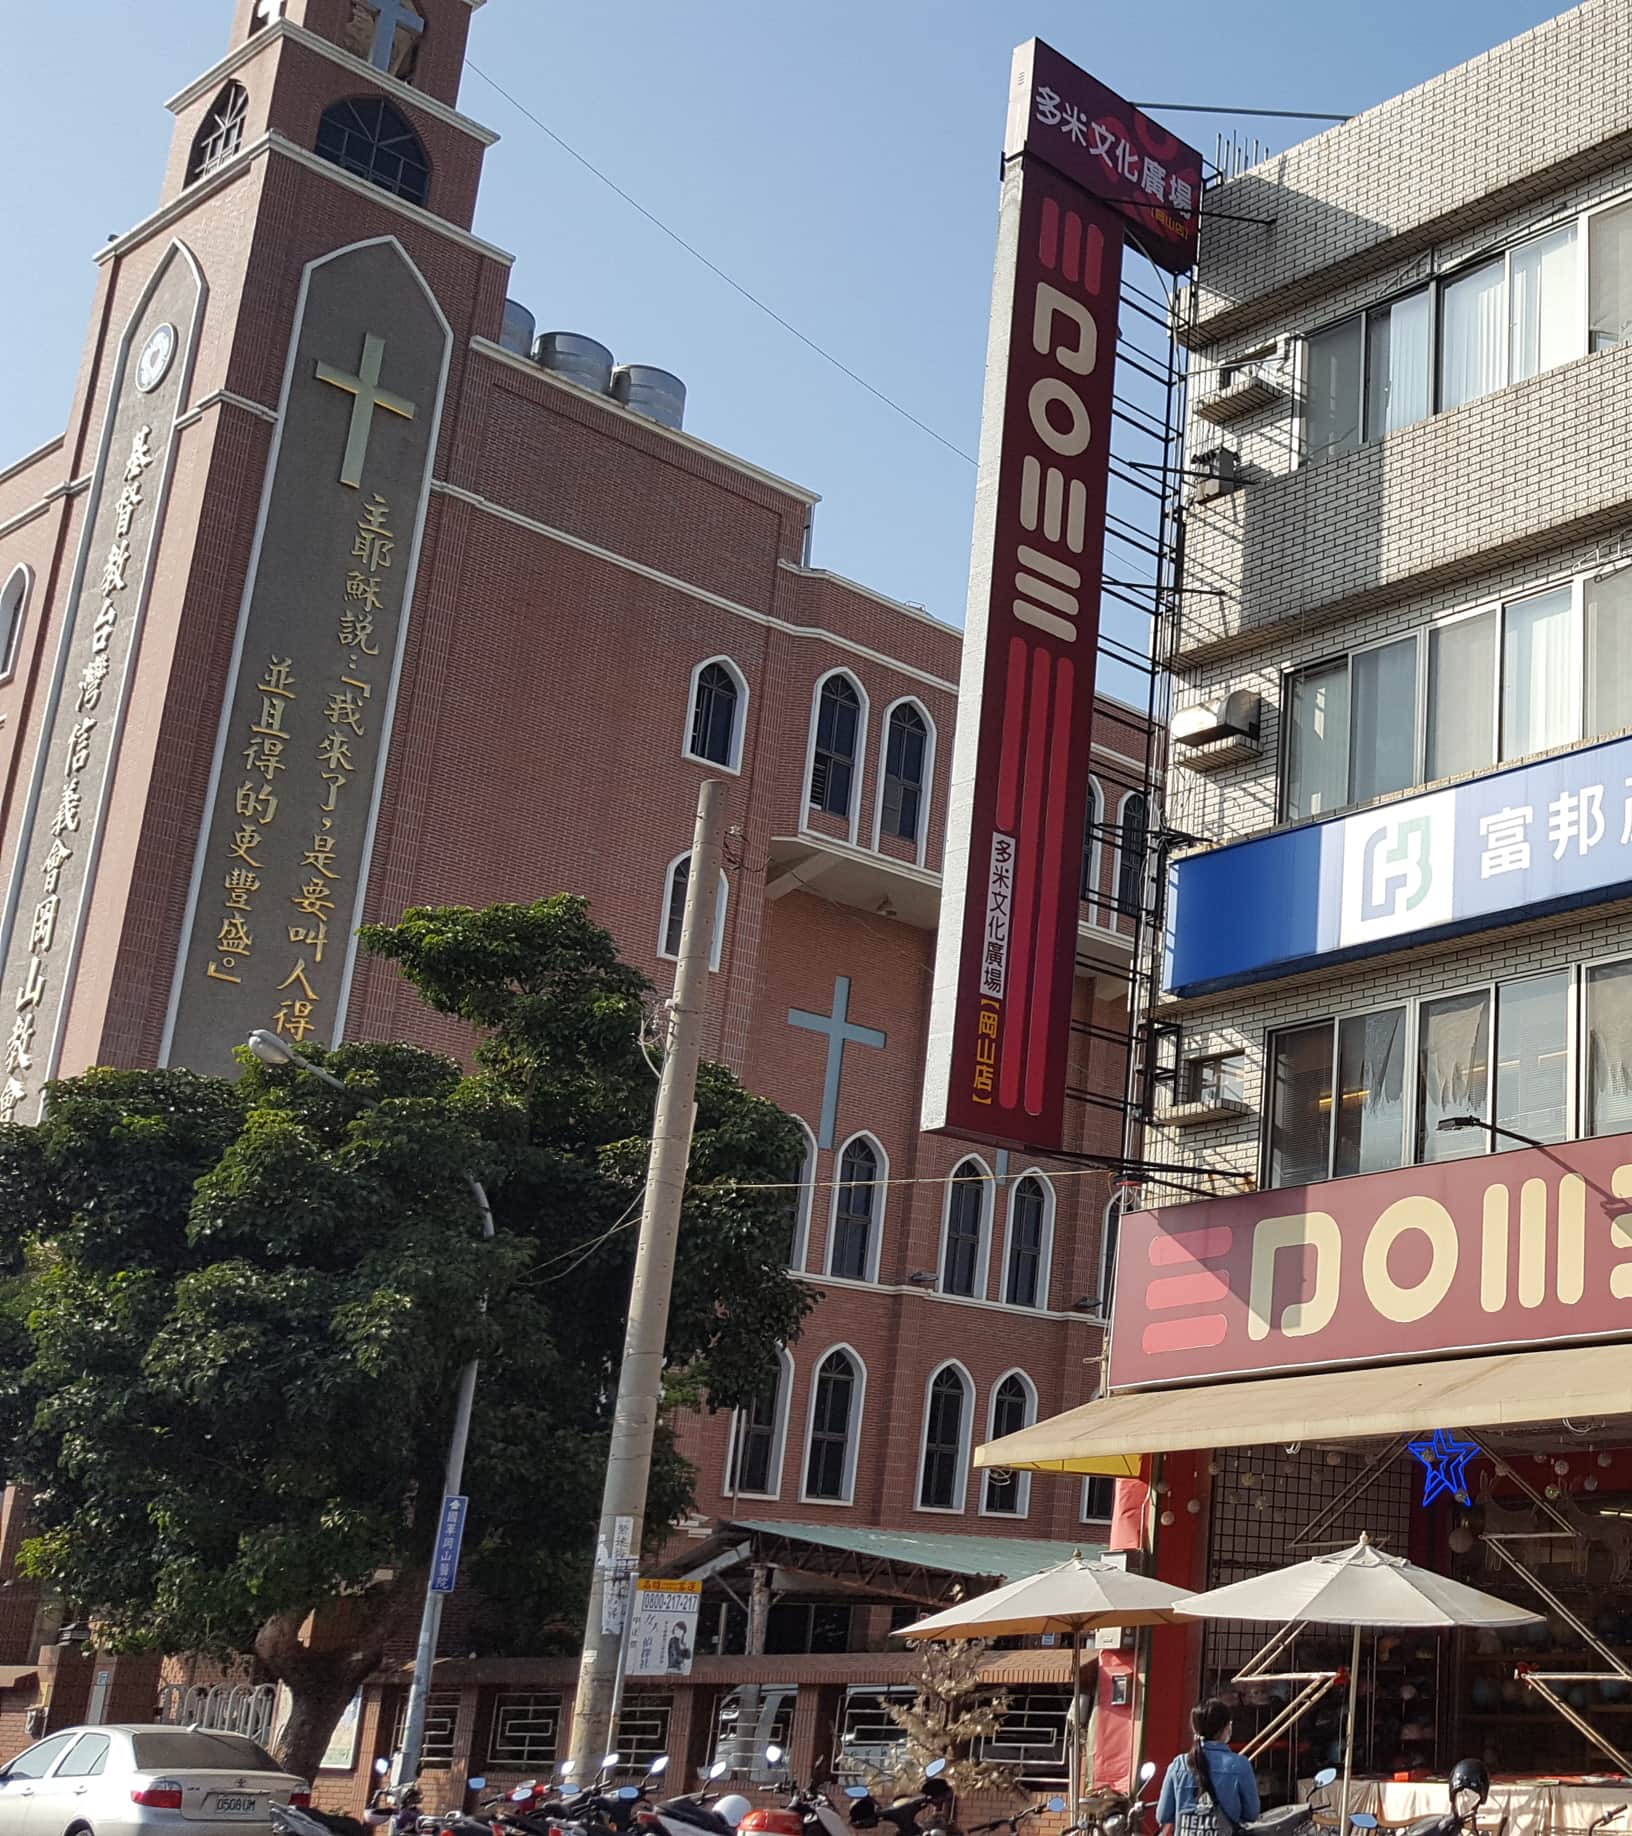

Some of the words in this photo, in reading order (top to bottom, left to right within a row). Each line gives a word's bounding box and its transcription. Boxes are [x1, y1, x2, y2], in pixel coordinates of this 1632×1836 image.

[1035, 86, 1193, 220] 多米文化廣場
[984, 839, 1012, 994] 多米文化廣場
